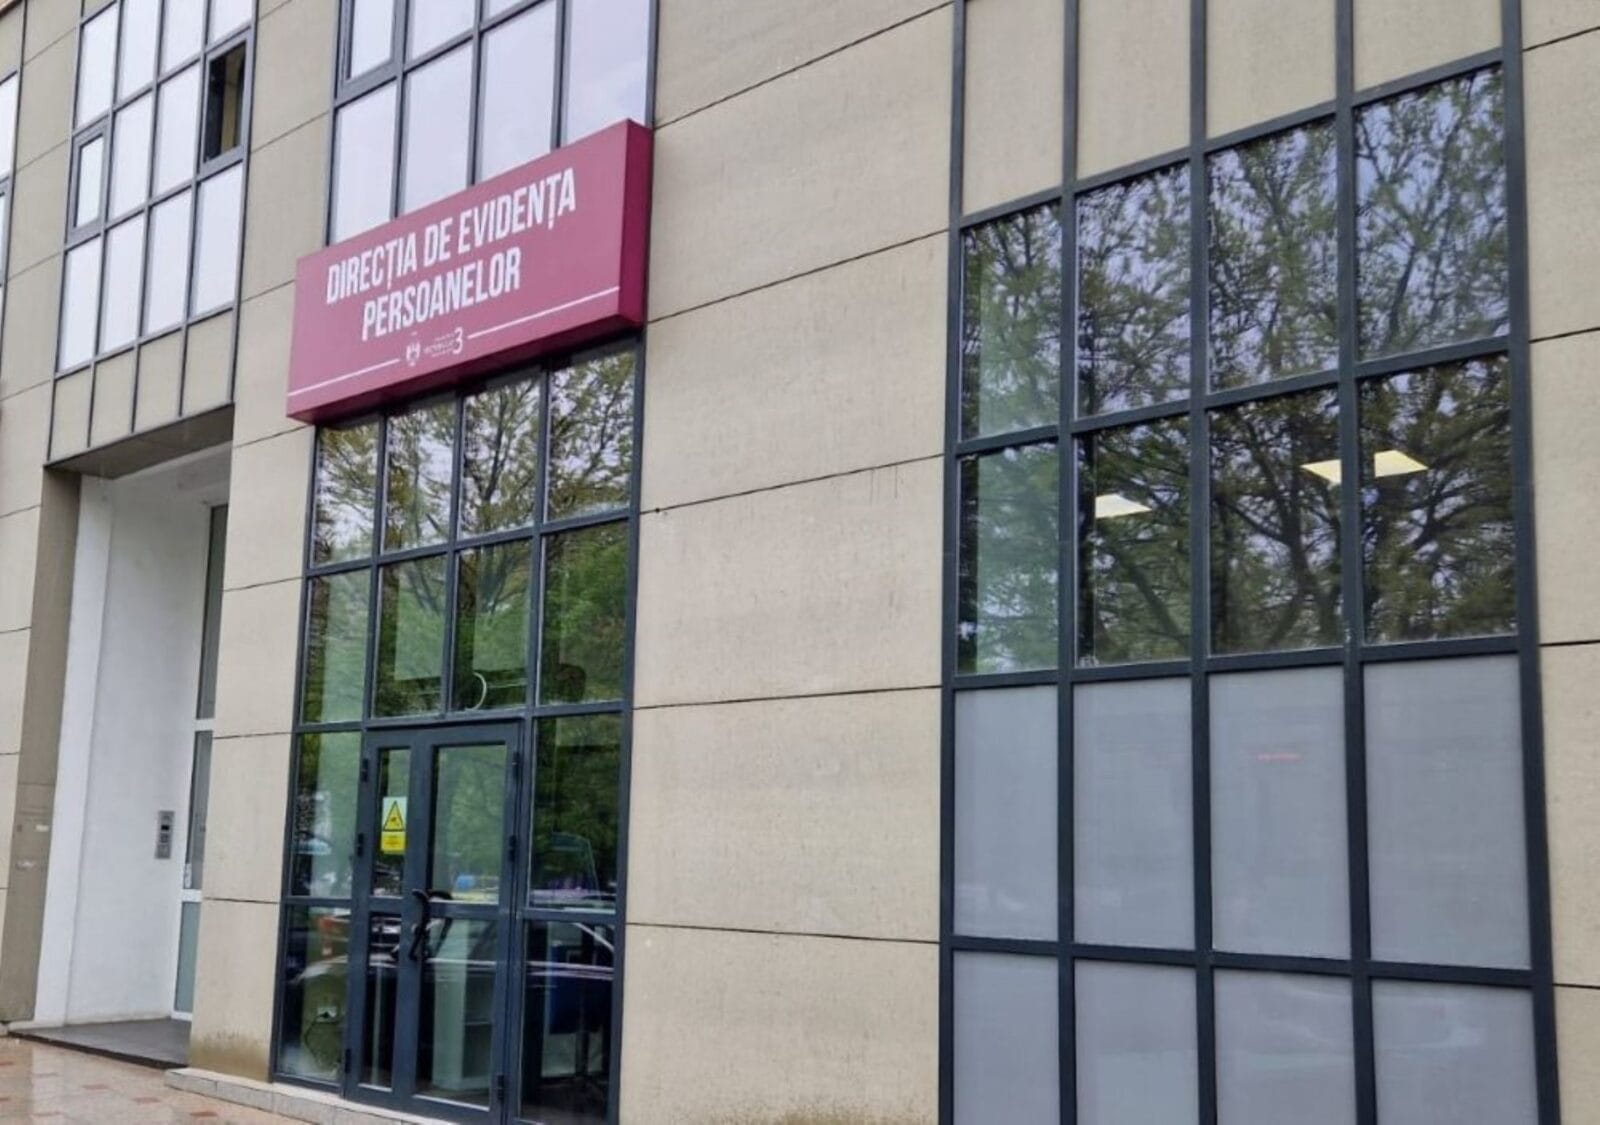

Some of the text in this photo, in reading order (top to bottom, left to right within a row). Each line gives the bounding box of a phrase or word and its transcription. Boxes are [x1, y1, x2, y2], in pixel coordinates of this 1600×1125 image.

[326, 168, 576, 304] DIRECȚIA DE EVIDENȚA
[361, 247, 521, 342] PERSOANELOR
[453, 327, 463, 354] 3
